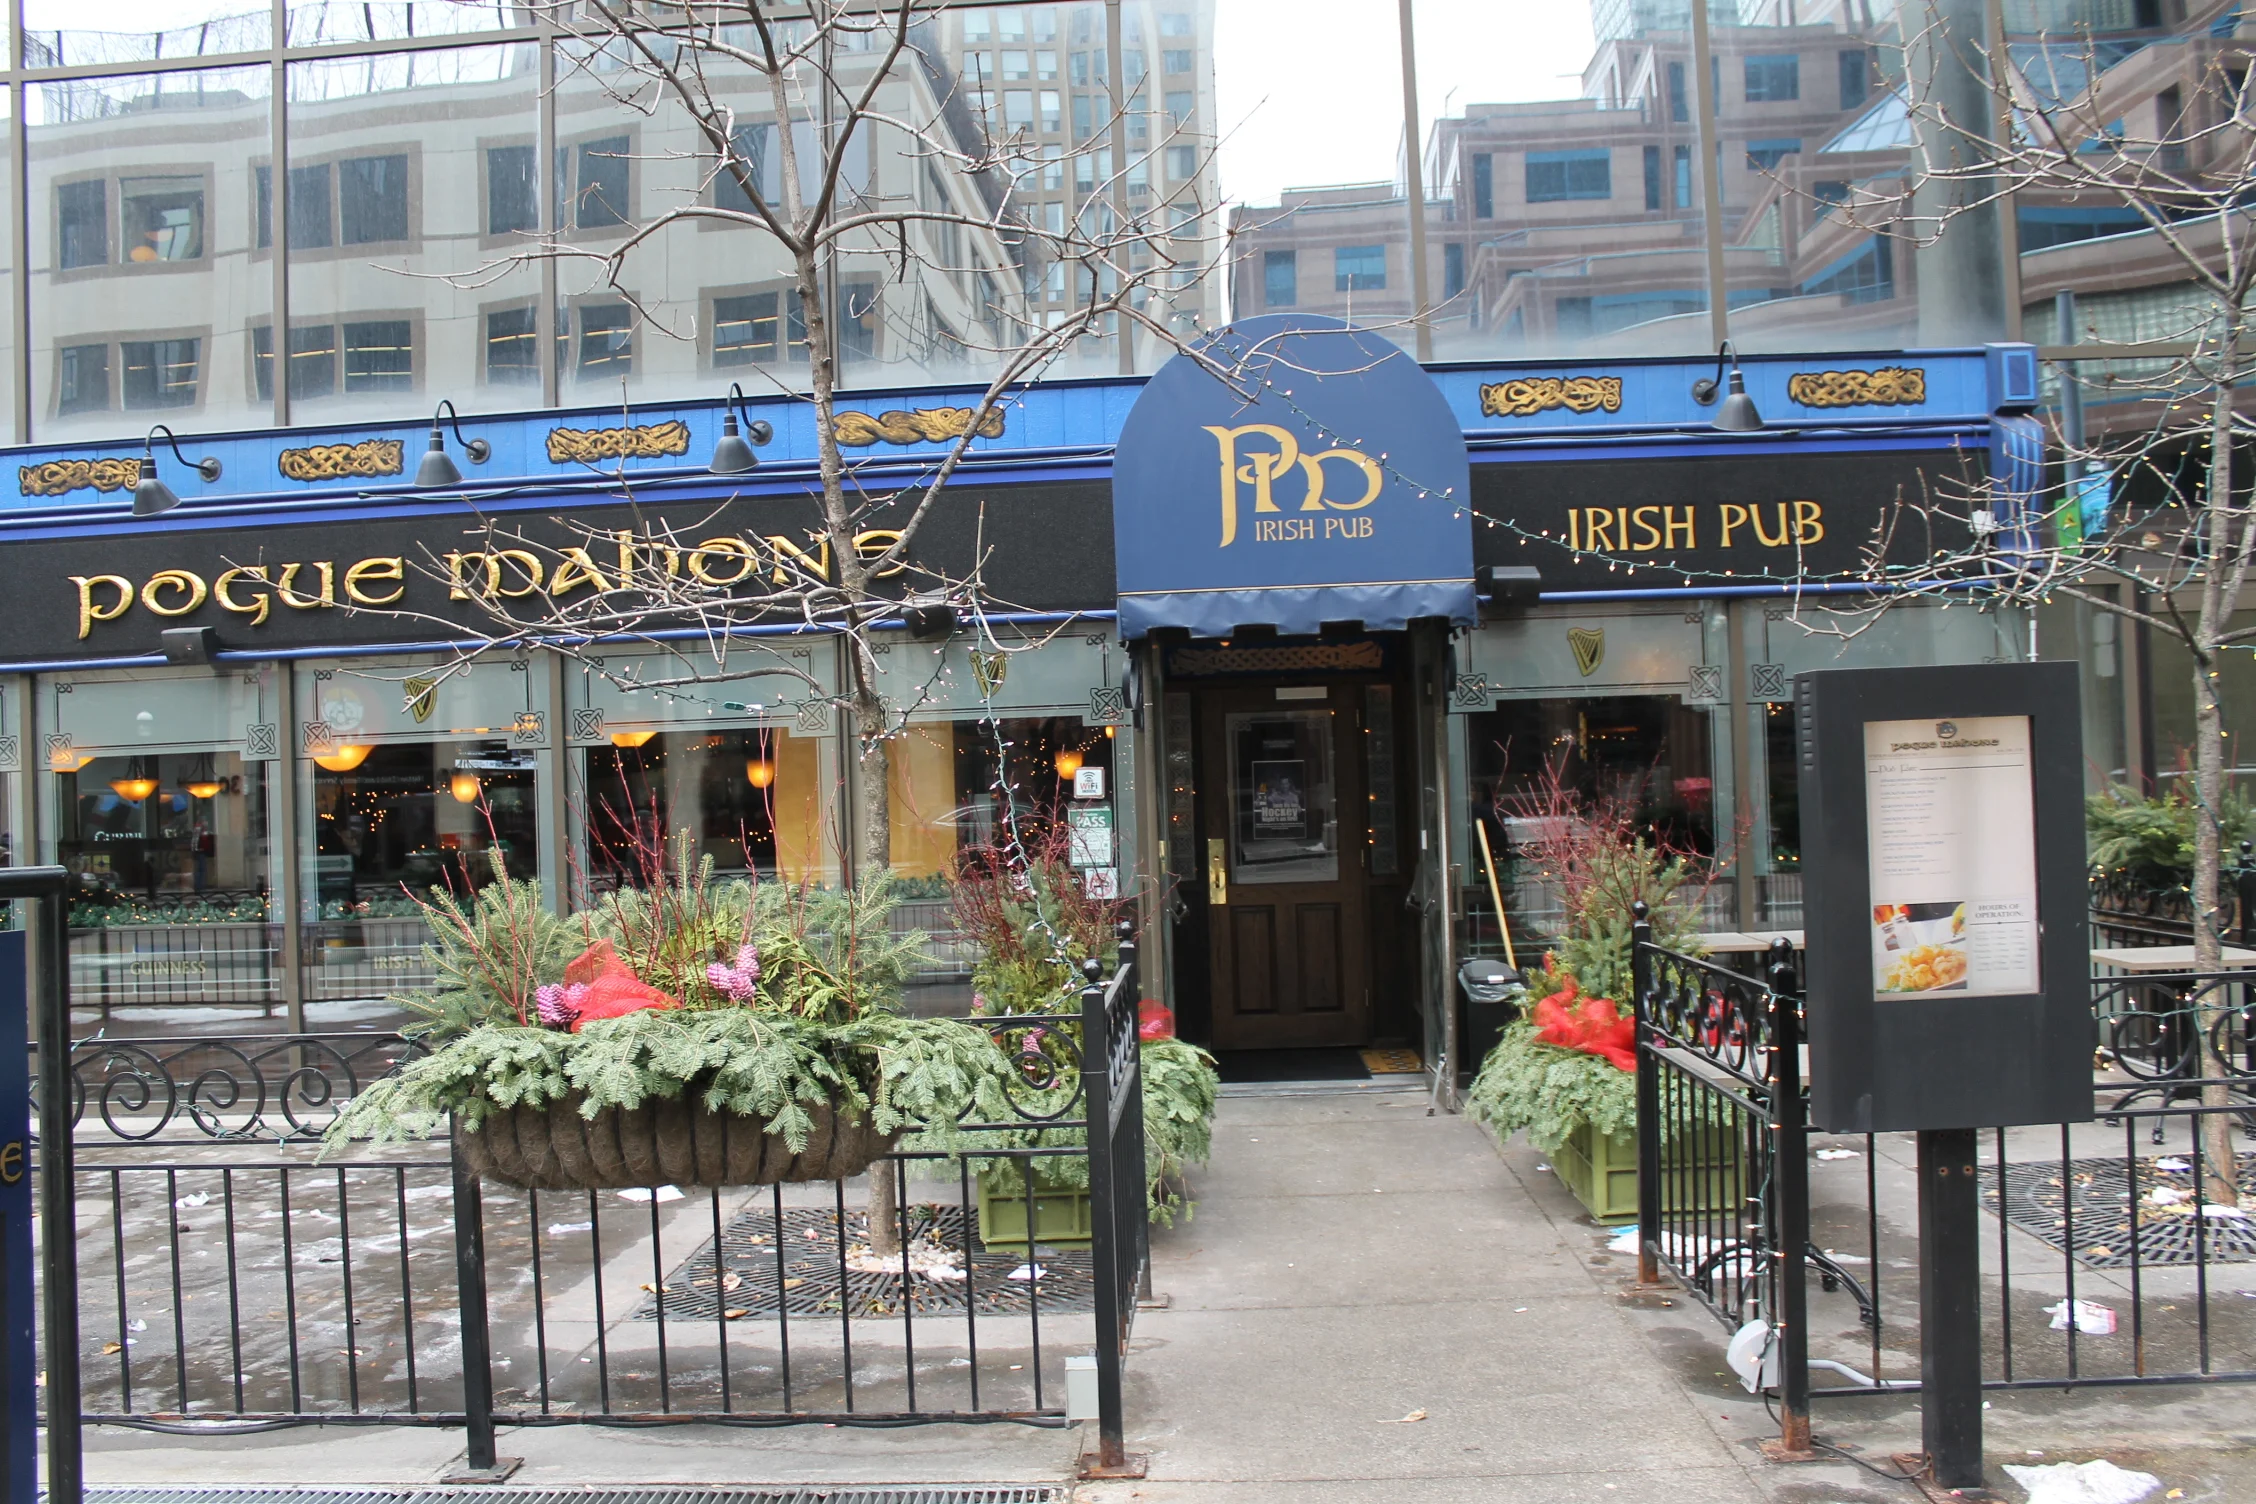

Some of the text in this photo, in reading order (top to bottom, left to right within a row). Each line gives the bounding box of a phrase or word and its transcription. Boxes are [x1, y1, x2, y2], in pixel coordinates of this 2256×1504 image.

[1255, 516, 1375, 542] IRISH PUB
[1567, 501, 1825, 552] IRISH PUB
[68, 528, 908, 640] POGUE MAHONE
[1076, 816, 1106, 828] PASS
[130, 960, 207, 976] GUINNESS
[374, 955, 413, 970] IRISH
